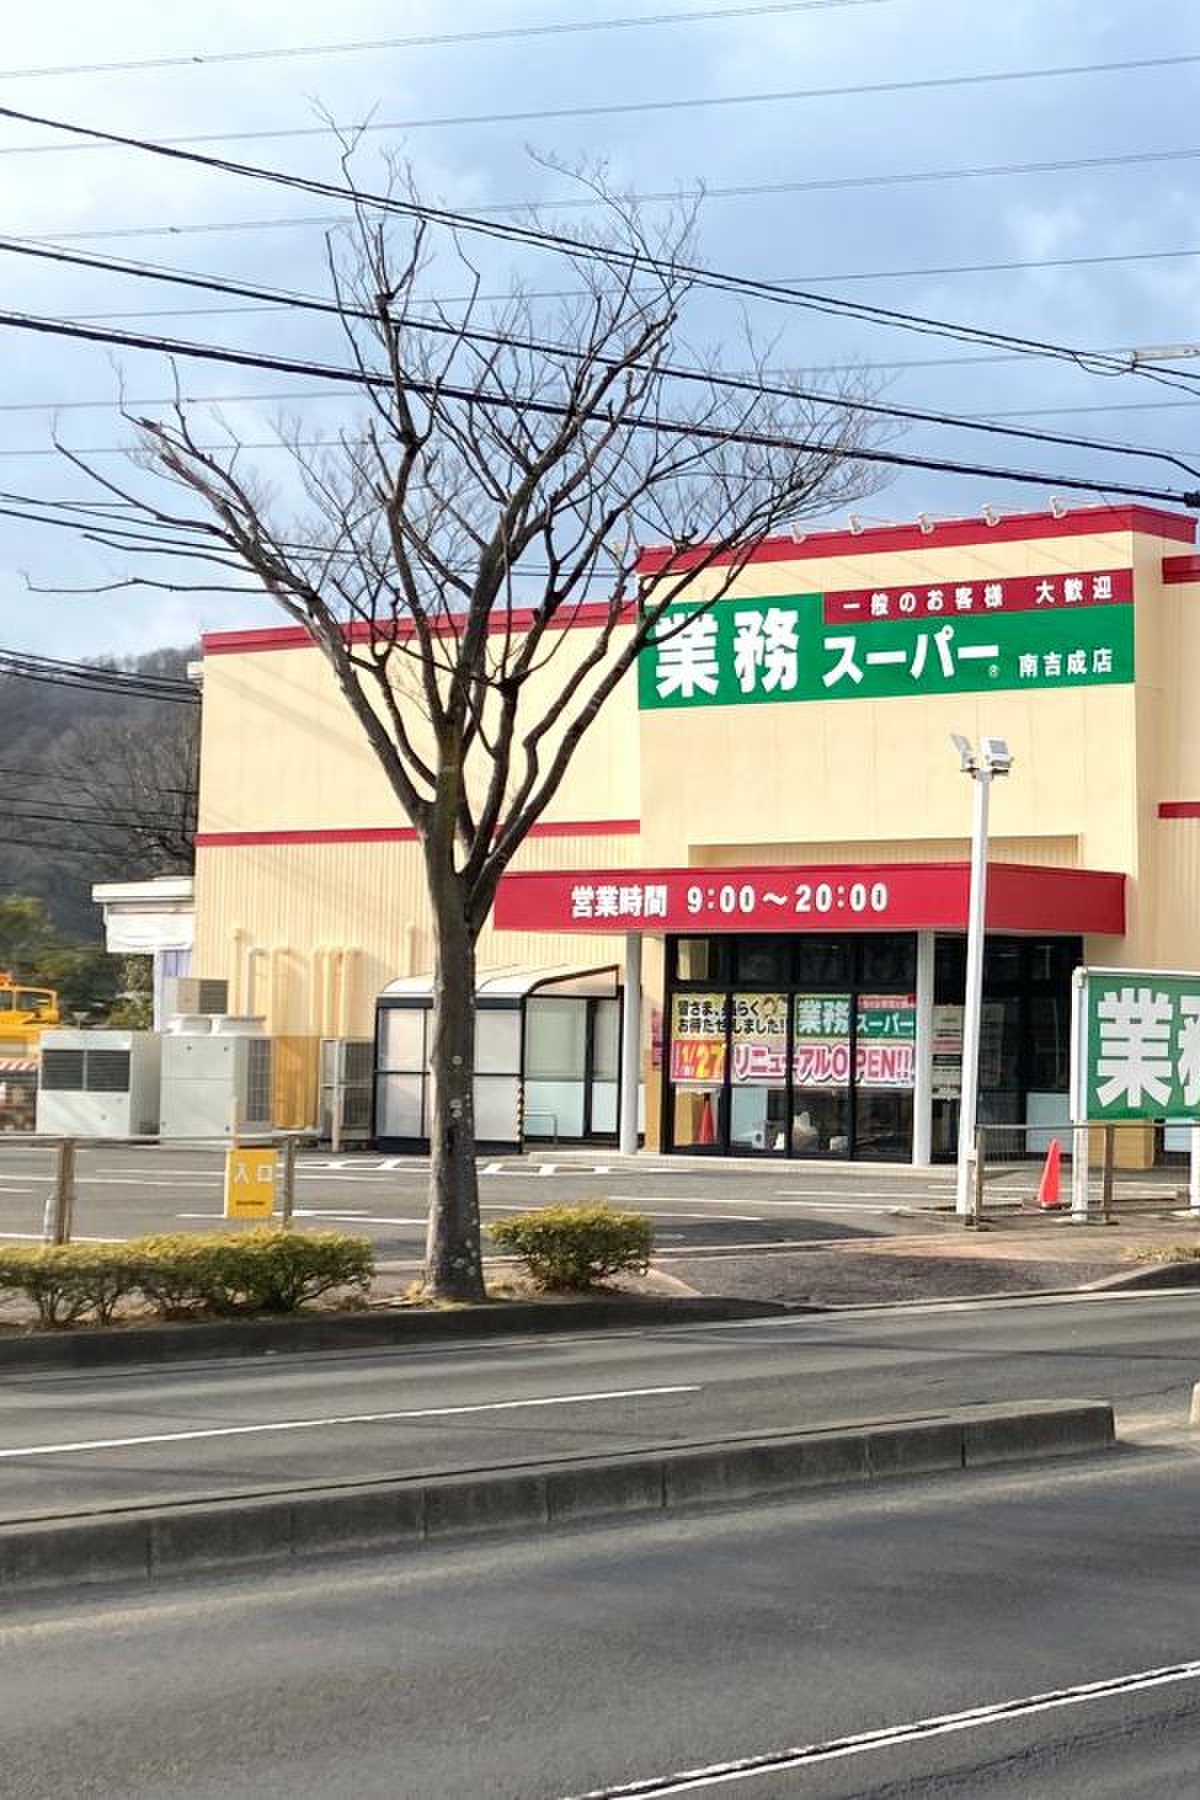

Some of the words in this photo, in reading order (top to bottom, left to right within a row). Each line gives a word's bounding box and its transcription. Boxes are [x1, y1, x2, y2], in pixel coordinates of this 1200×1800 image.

[842, 583, 1003, 616] 一般のお客様
[1035, 575, 1113, 605] 大歓迎
[1018, 647, 1113, 679] 南吉成店
[571, 885, 668, 918] 営業時間
[234, 1163, 273, 1185] 入口
